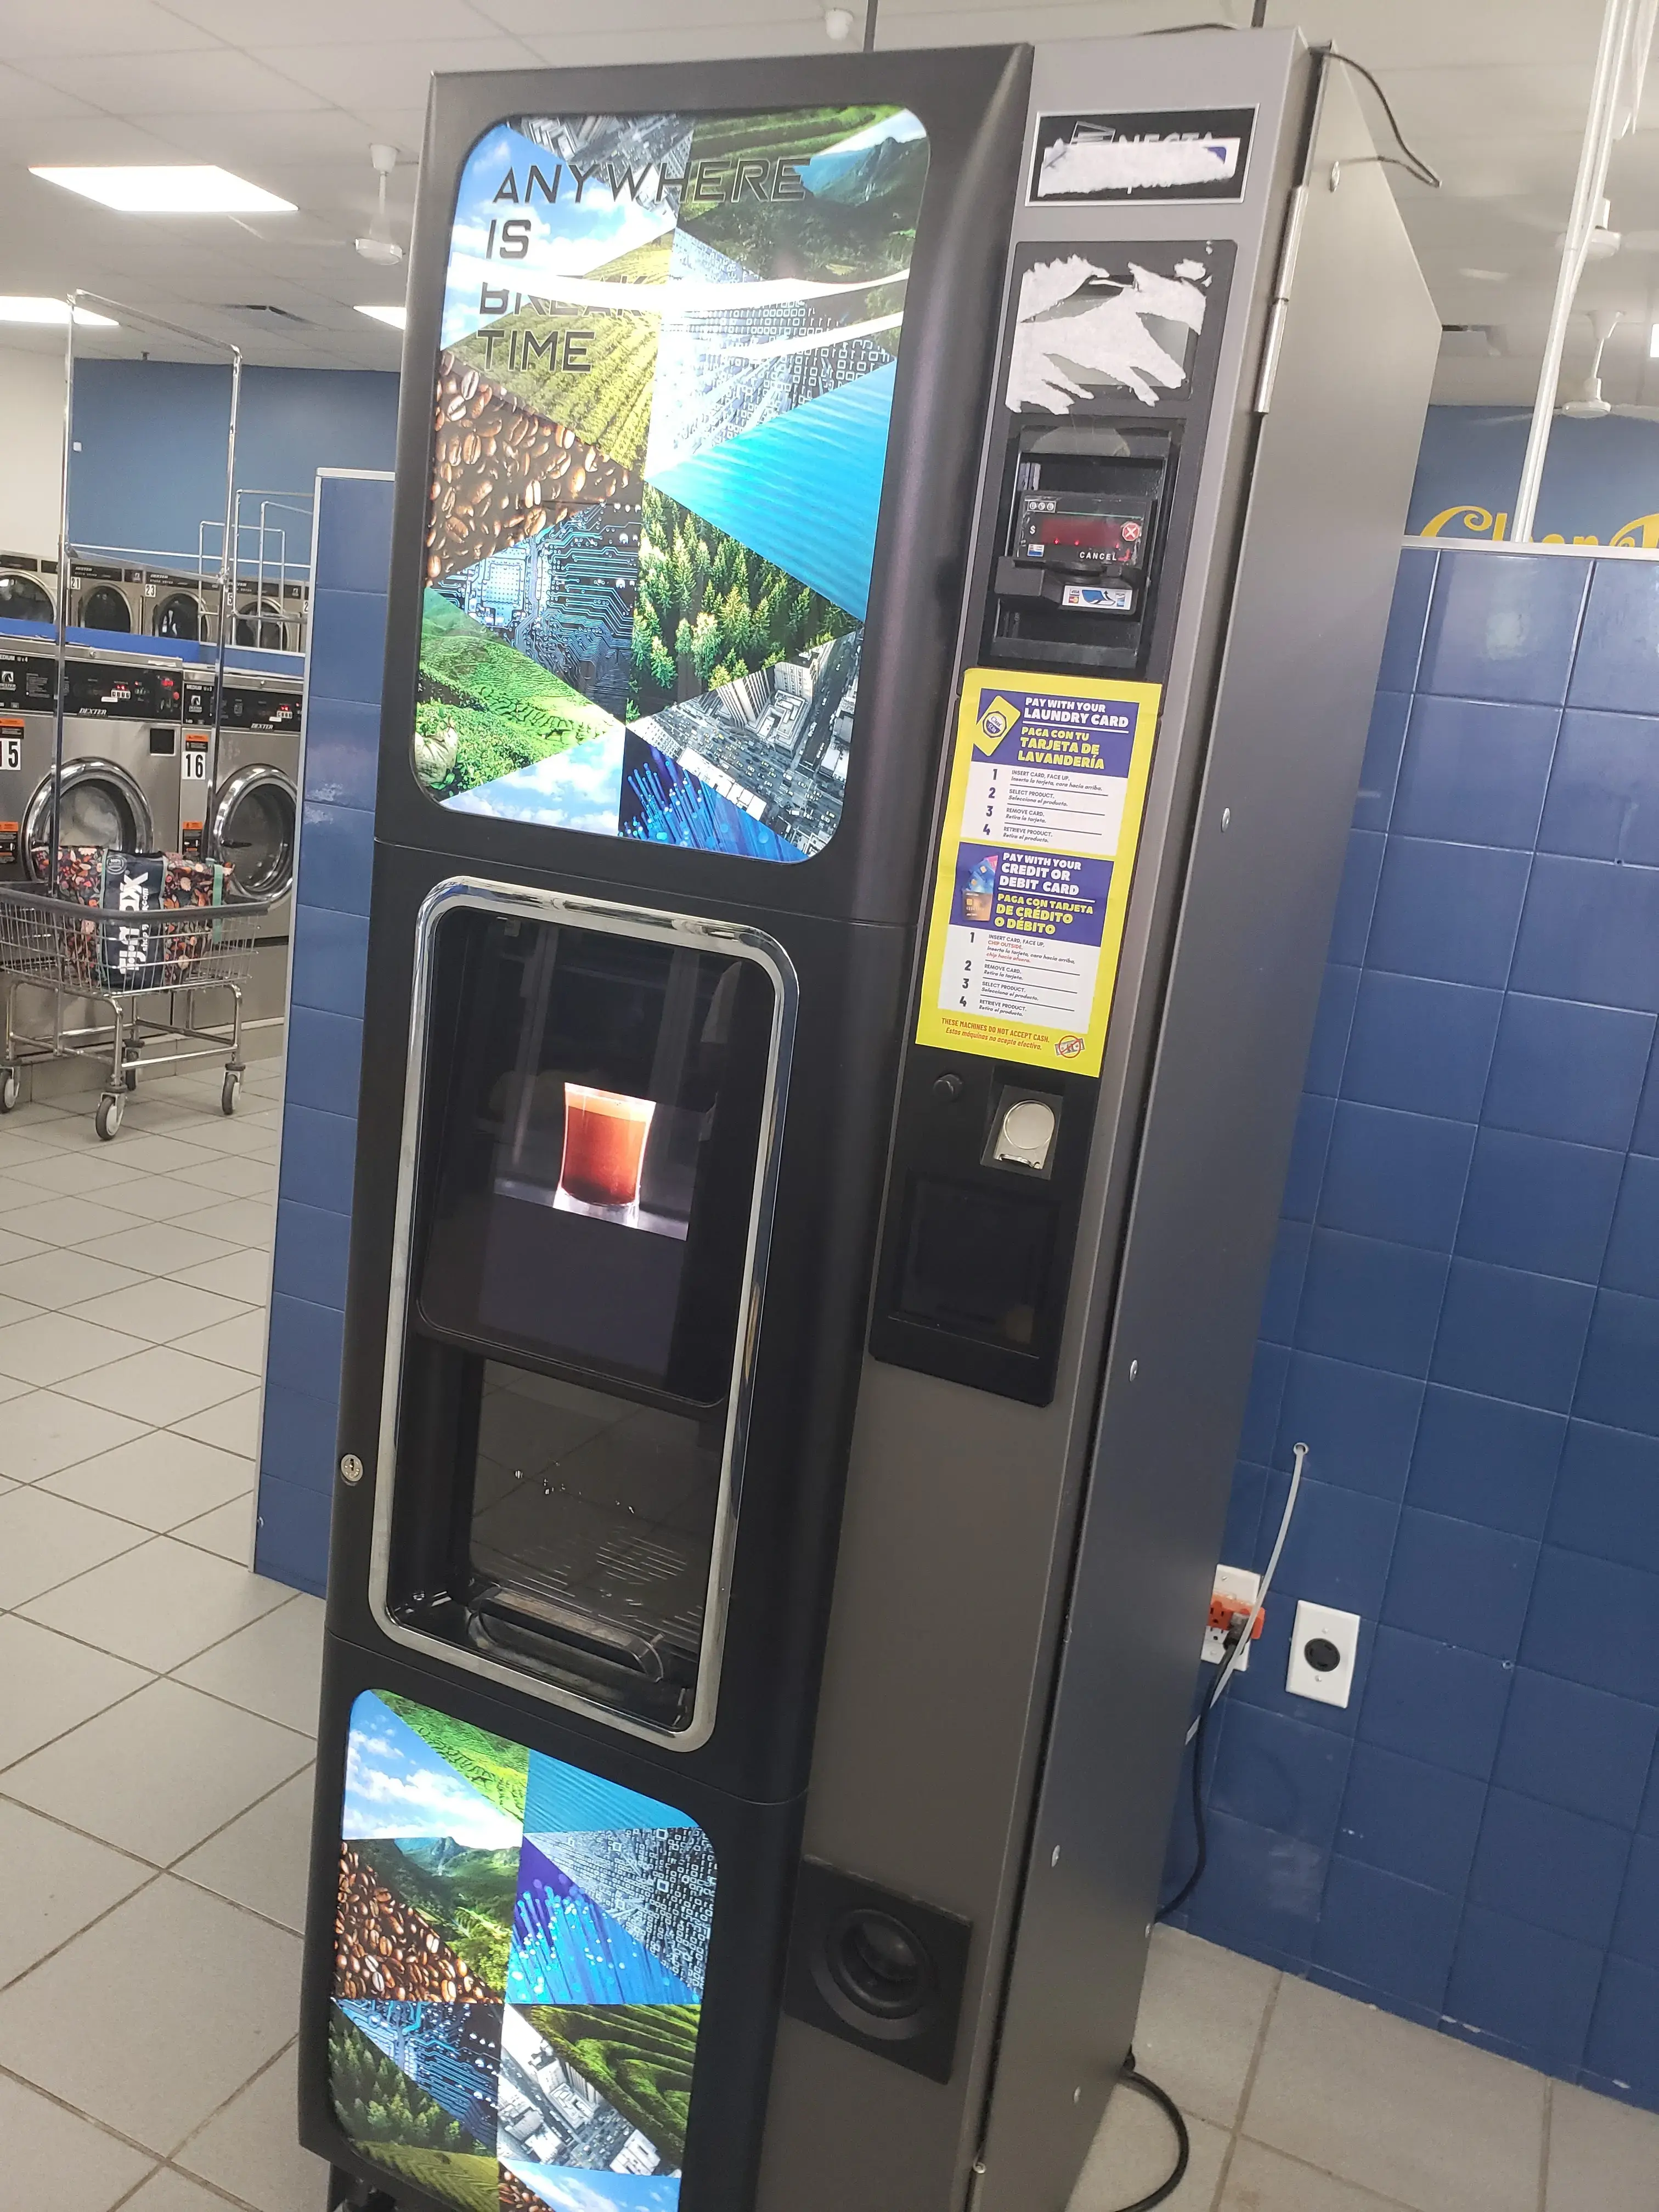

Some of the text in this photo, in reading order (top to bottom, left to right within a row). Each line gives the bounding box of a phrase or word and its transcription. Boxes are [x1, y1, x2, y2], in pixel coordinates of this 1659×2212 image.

[494, 158, 811, 204] ANYWHERE
[486, 219, 531, 260] IS
[476, 330, 595, 373] TIME
[1030, 525, 1036, 535] $
[1080, 552, 1116, 561] CANCEL
[72, 578, 79, 588] 21
[146, 585, 155, 595] 23
[228, 594, 232, 603] 5
[305, 602, 308, 611] 2
[1025, 697, 1105, 713] PAY WITH YOUR
[1024, 708, 1128, 727] LAUNDRY CARD
[1022, 727, 1089, 741] PAGA CON TU
[1020, 737, 1099, 755] TARJETA DE
[186, 754, 203, 778] 16
[1018, 751, 1104, 769] LAVANDERÍA
[993, 769, 997, 780] 1
[988, 787, 996, 798] 2
[986, 806, 993, 816] 3
[983, 824, 990, 835] 4
[1003, 853, 1082, 870] PAY WITH YOUR
[1002, 863, 1070, 881] CREDIT OR
[1000, 876, 1079, 895] DEBIT CARD
[997, 894, 1093, 914] PAGA CON TARJETA
[996, 904, 1073, 924] DE CRÉDITO
[995, 917, 1056, 934] O DÉBITO
[970, 932, 974, 943] 1
[964, 960, 971, 971] 2
[962, 978, 969, 989] 3
[1001, 984, 1025, 992] PRODUCT.
[981, 988, 1008, 996] Selecciona
[1015, 992, 1039, 1001] producto.
[960, 996, 967, 1007] 4
[1002, 1003, 1026, 1011] PRODUCT.
[1000, 1008, 1023, 1017] producto.
[941, 1018, 958, 1026] THESE
[960, 1021, 987, 1031] MACHINES
[1010, 1030, 1032, 1040] ACCEPT
[1034, 1034, 1049, 1042] CASH.
[962, 1031, 988, 1041] máquinas
[997, 1037, 1016, 1046] acepta
[1018, 1041, 1042, 1051] efectivo.
